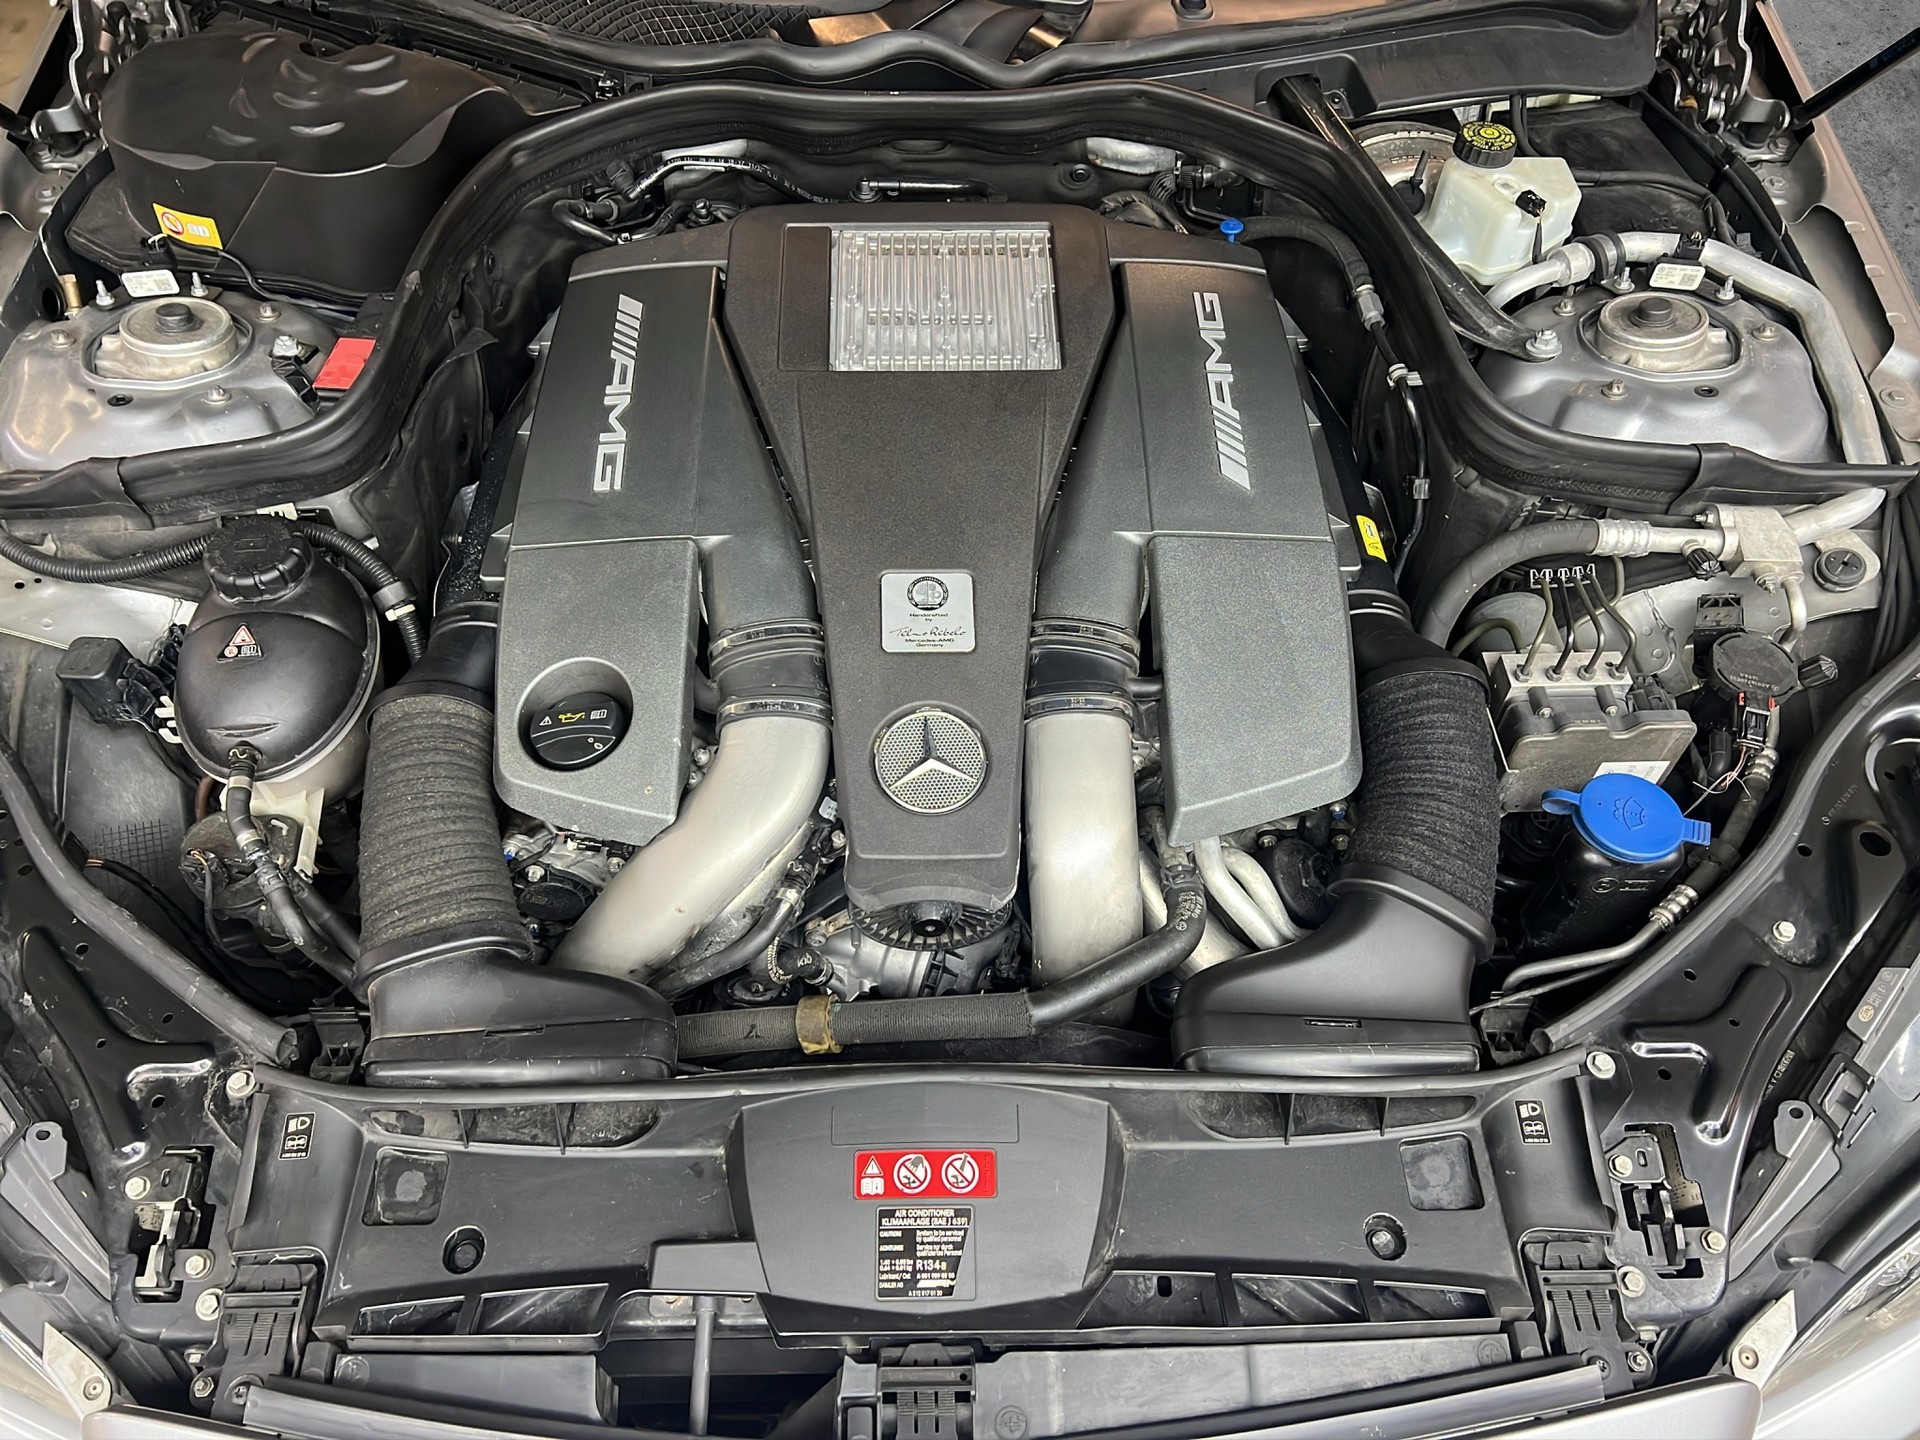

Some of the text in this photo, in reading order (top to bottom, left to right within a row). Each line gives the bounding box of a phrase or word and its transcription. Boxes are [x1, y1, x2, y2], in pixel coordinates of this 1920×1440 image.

[1193, 292, 1240, 421] AMG
[594, 349, 636, 491] AMG
[894, 1209, 955, 1217] AIR CONDITIONER
[881, 1218, 930, 1226] KLIMAANLAGE
[916, 1260, 947, 1271] R134a
